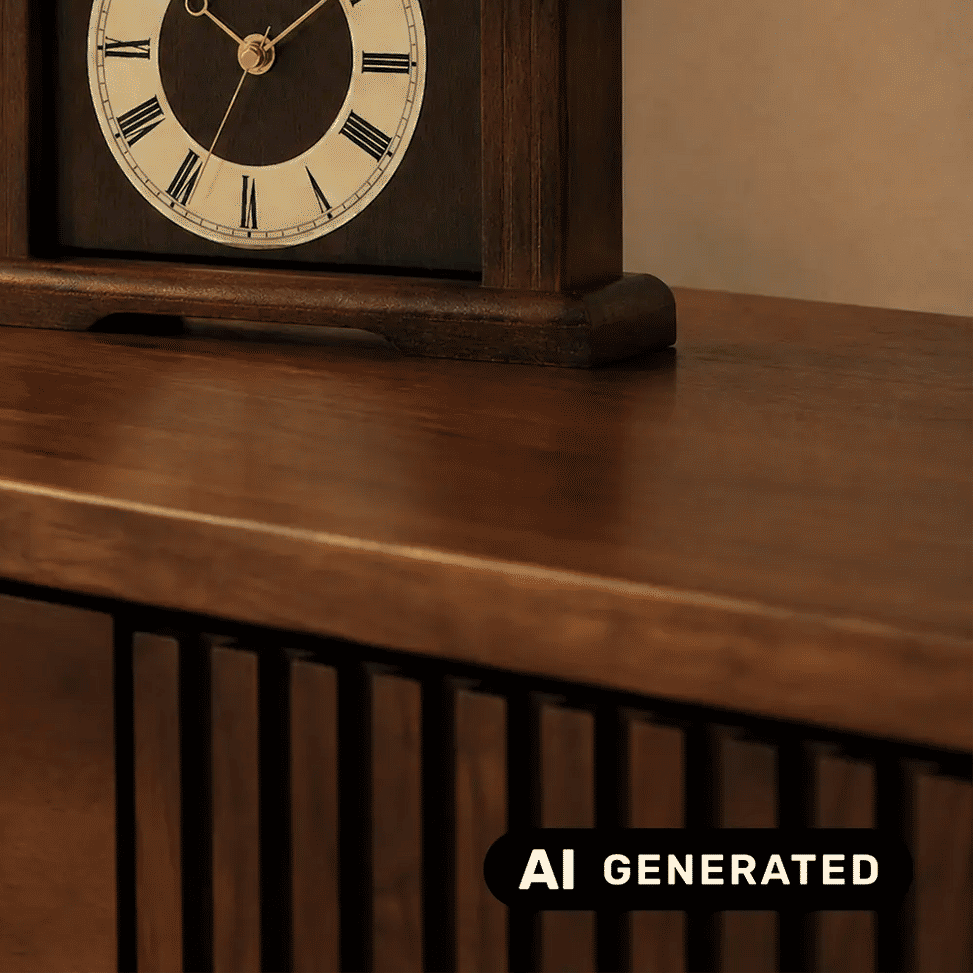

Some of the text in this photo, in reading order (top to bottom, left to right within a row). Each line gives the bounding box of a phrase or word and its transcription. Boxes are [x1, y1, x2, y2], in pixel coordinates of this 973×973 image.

[104, 36, 151, 60] IX
[361, 50, 411, 75] III
[116, 94, 166, 148] VIII
[338, 109, 393, 163] IIII
[165, 148, 203, 207] VII
[239, 174, 259, 230] VI
[305, 165, 333, 214] V
